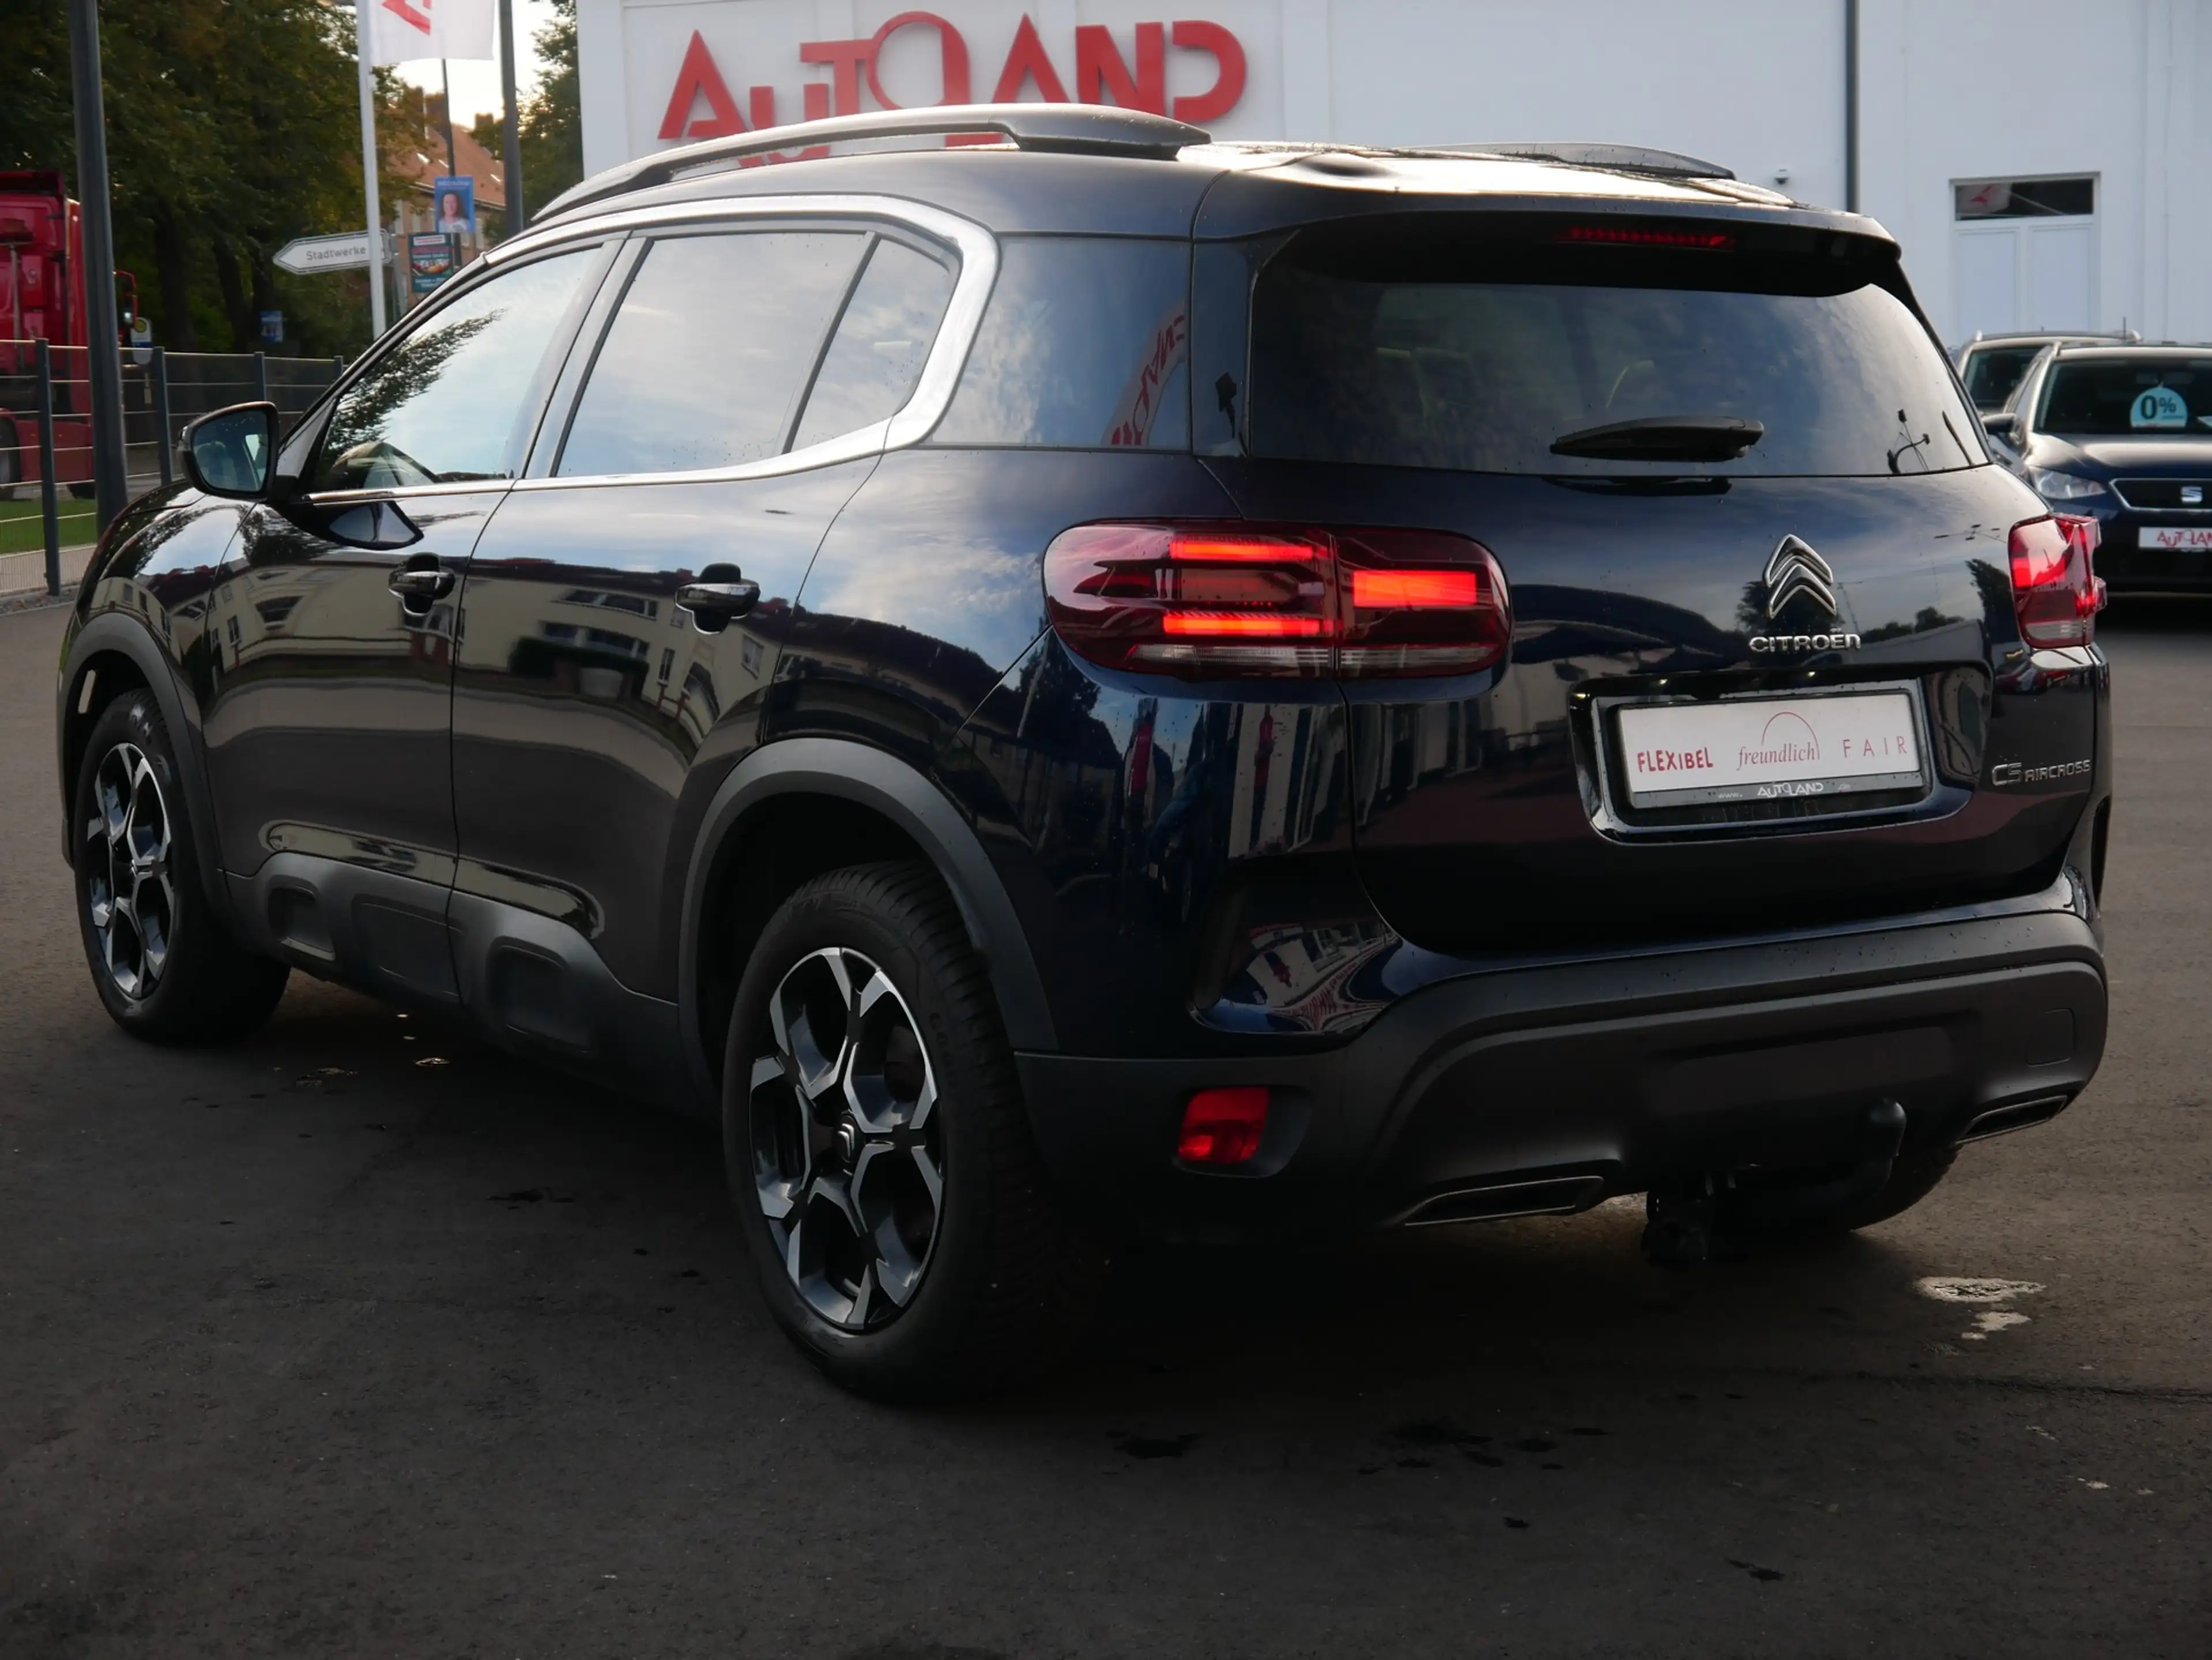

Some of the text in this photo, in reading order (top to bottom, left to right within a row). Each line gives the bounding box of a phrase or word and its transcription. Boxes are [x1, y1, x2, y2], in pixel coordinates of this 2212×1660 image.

[306, 246, 367, 261] Stadtwerke
[1637, 747, 1714, 773] FLEXIBEL
[1736, 741, 1817, 771] freundlich
[1992, 759, 2091, 786] C5 AIRCROSS
[1757, 782, 1824, 798] AUTOLAND
